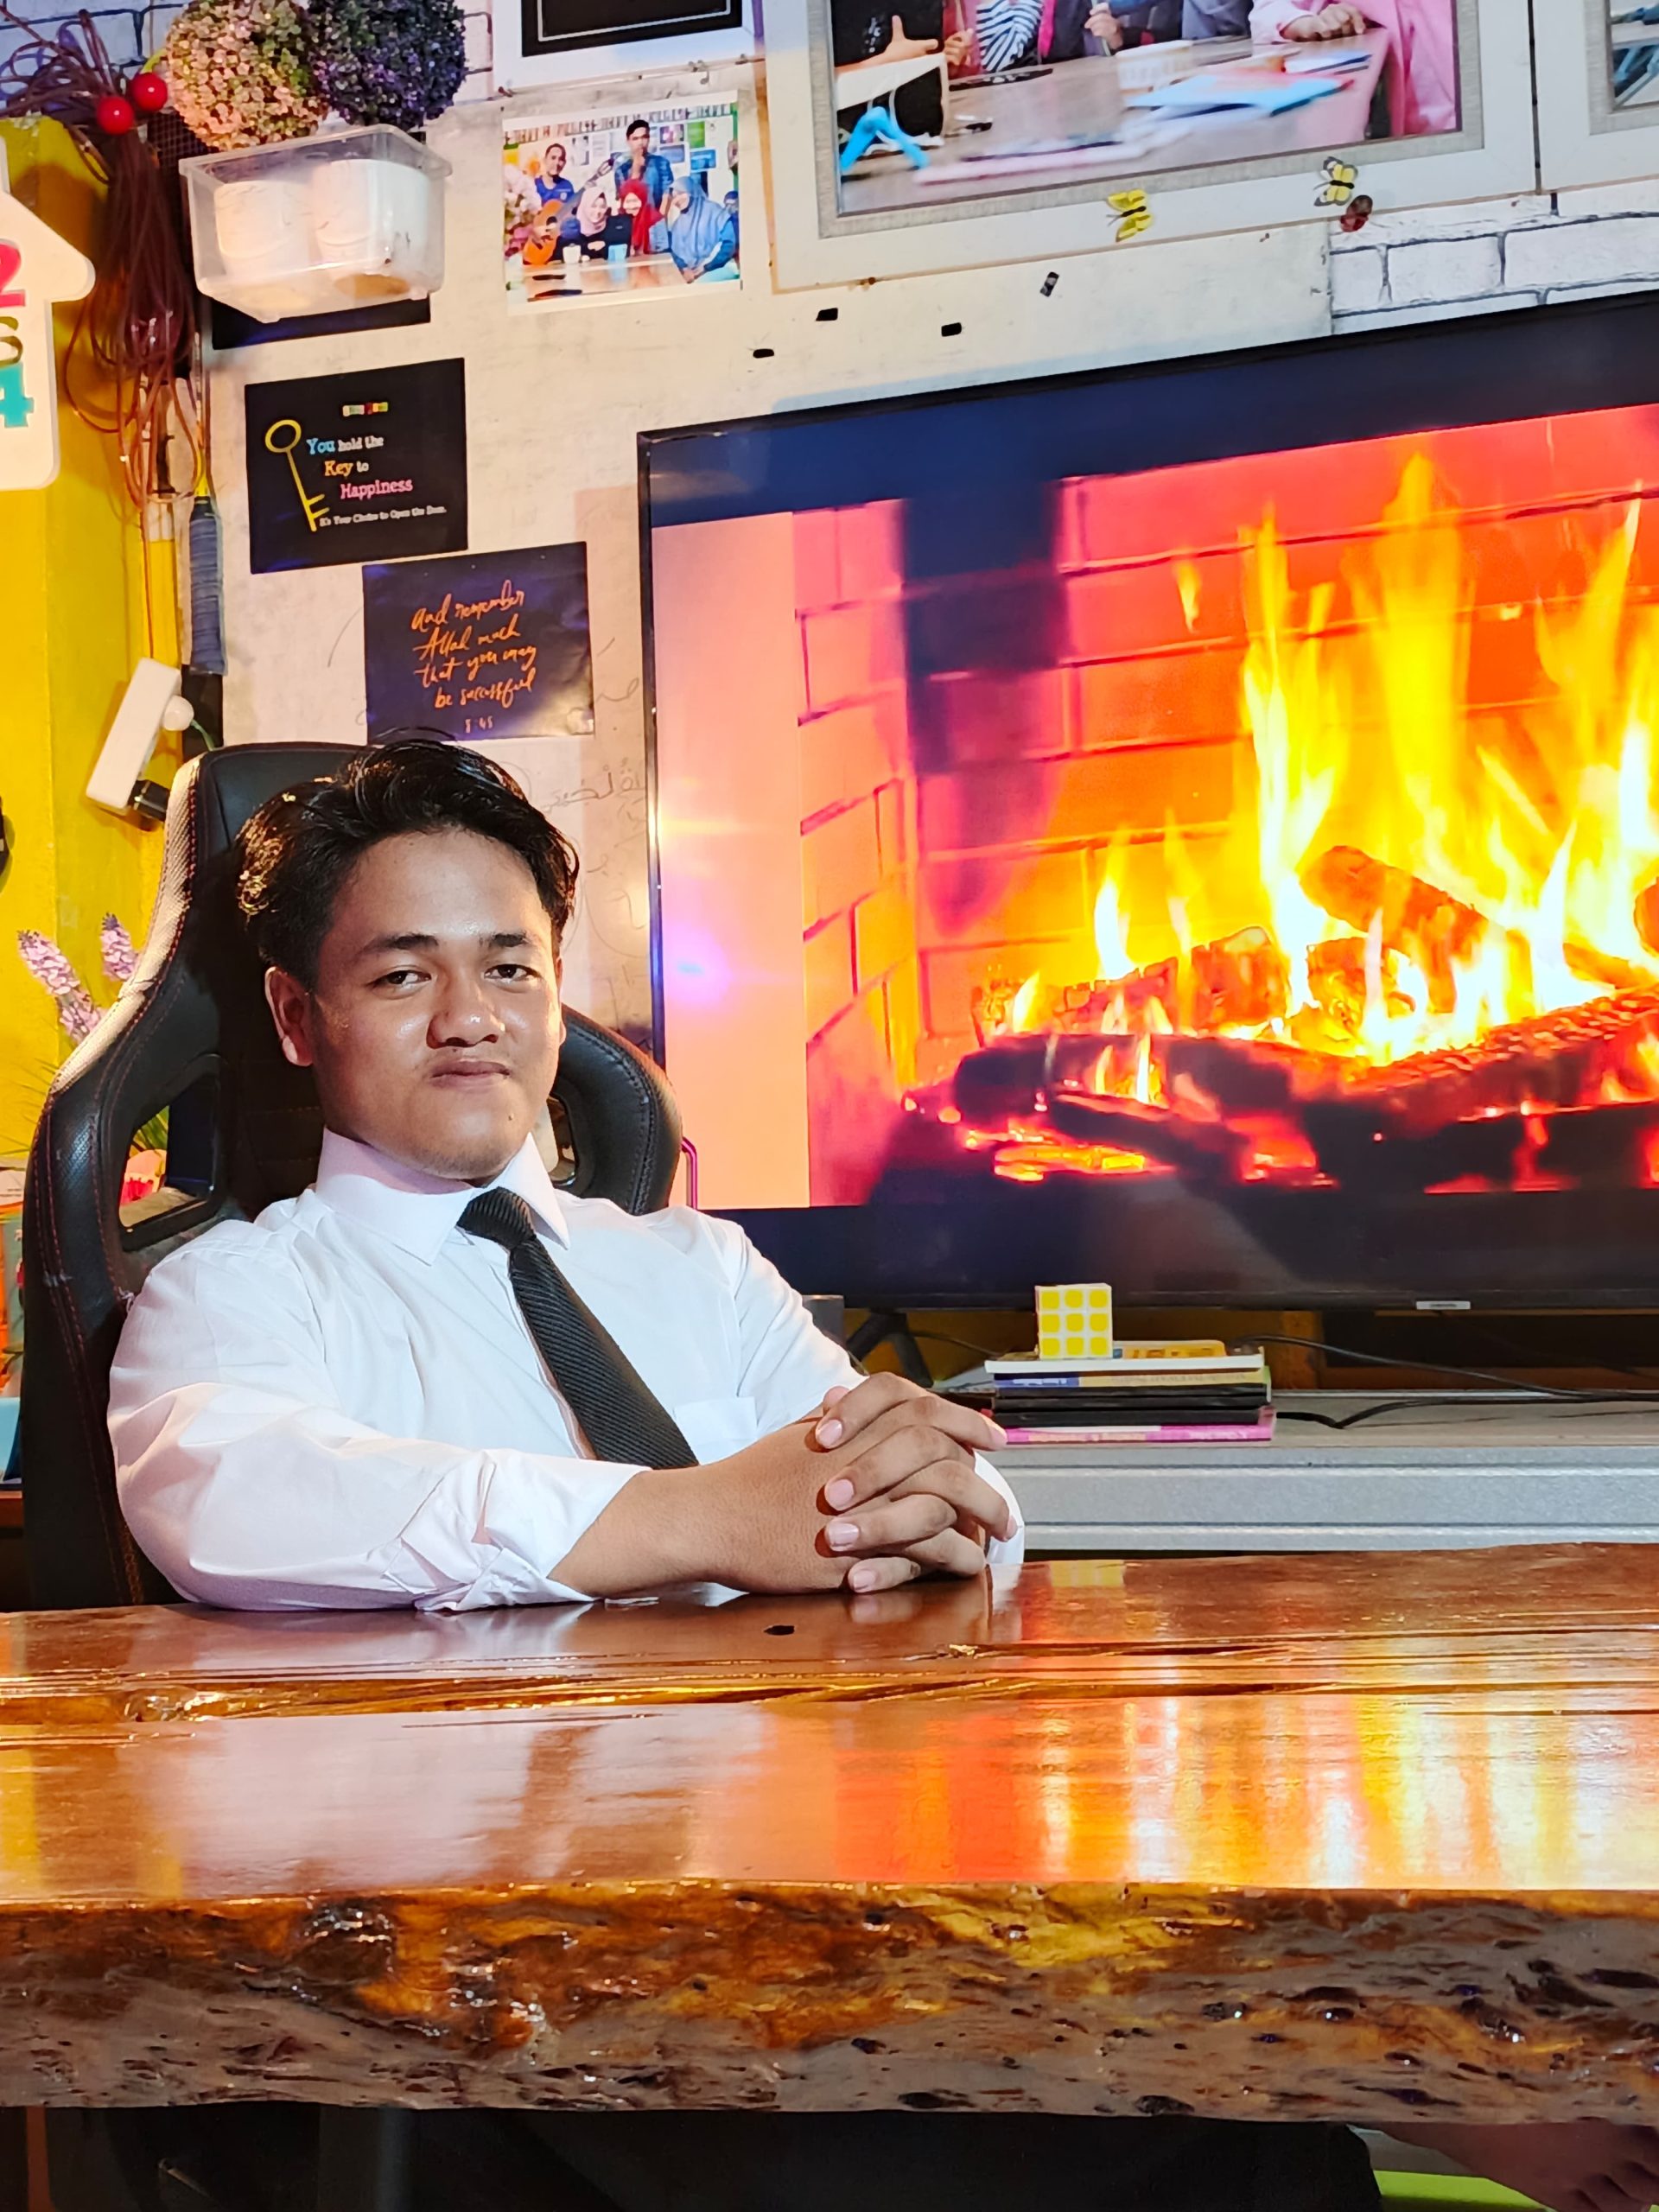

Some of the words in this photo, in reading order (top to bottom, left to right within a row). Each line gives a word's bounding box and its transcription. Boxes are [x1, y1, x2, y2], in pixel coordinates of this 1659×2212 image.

[306, 437, 336, 454] You
[338, 437, 363, 452] hold
[365, 435, 385, 448] the
[324, 460, 354, 478] Key
[356, 461, 370, 473] to
[340, 479, 414, 500] Happiness
[454, 580, 525, 620] remember
[412, 626, 473, 661] Allah
[413, 657, 464, 689] that
[467, 651, 499, 681] you
[503, 645, 537, 671] may
[435, 687, 453, 708] be
[460, 667, 537, 708] successful
